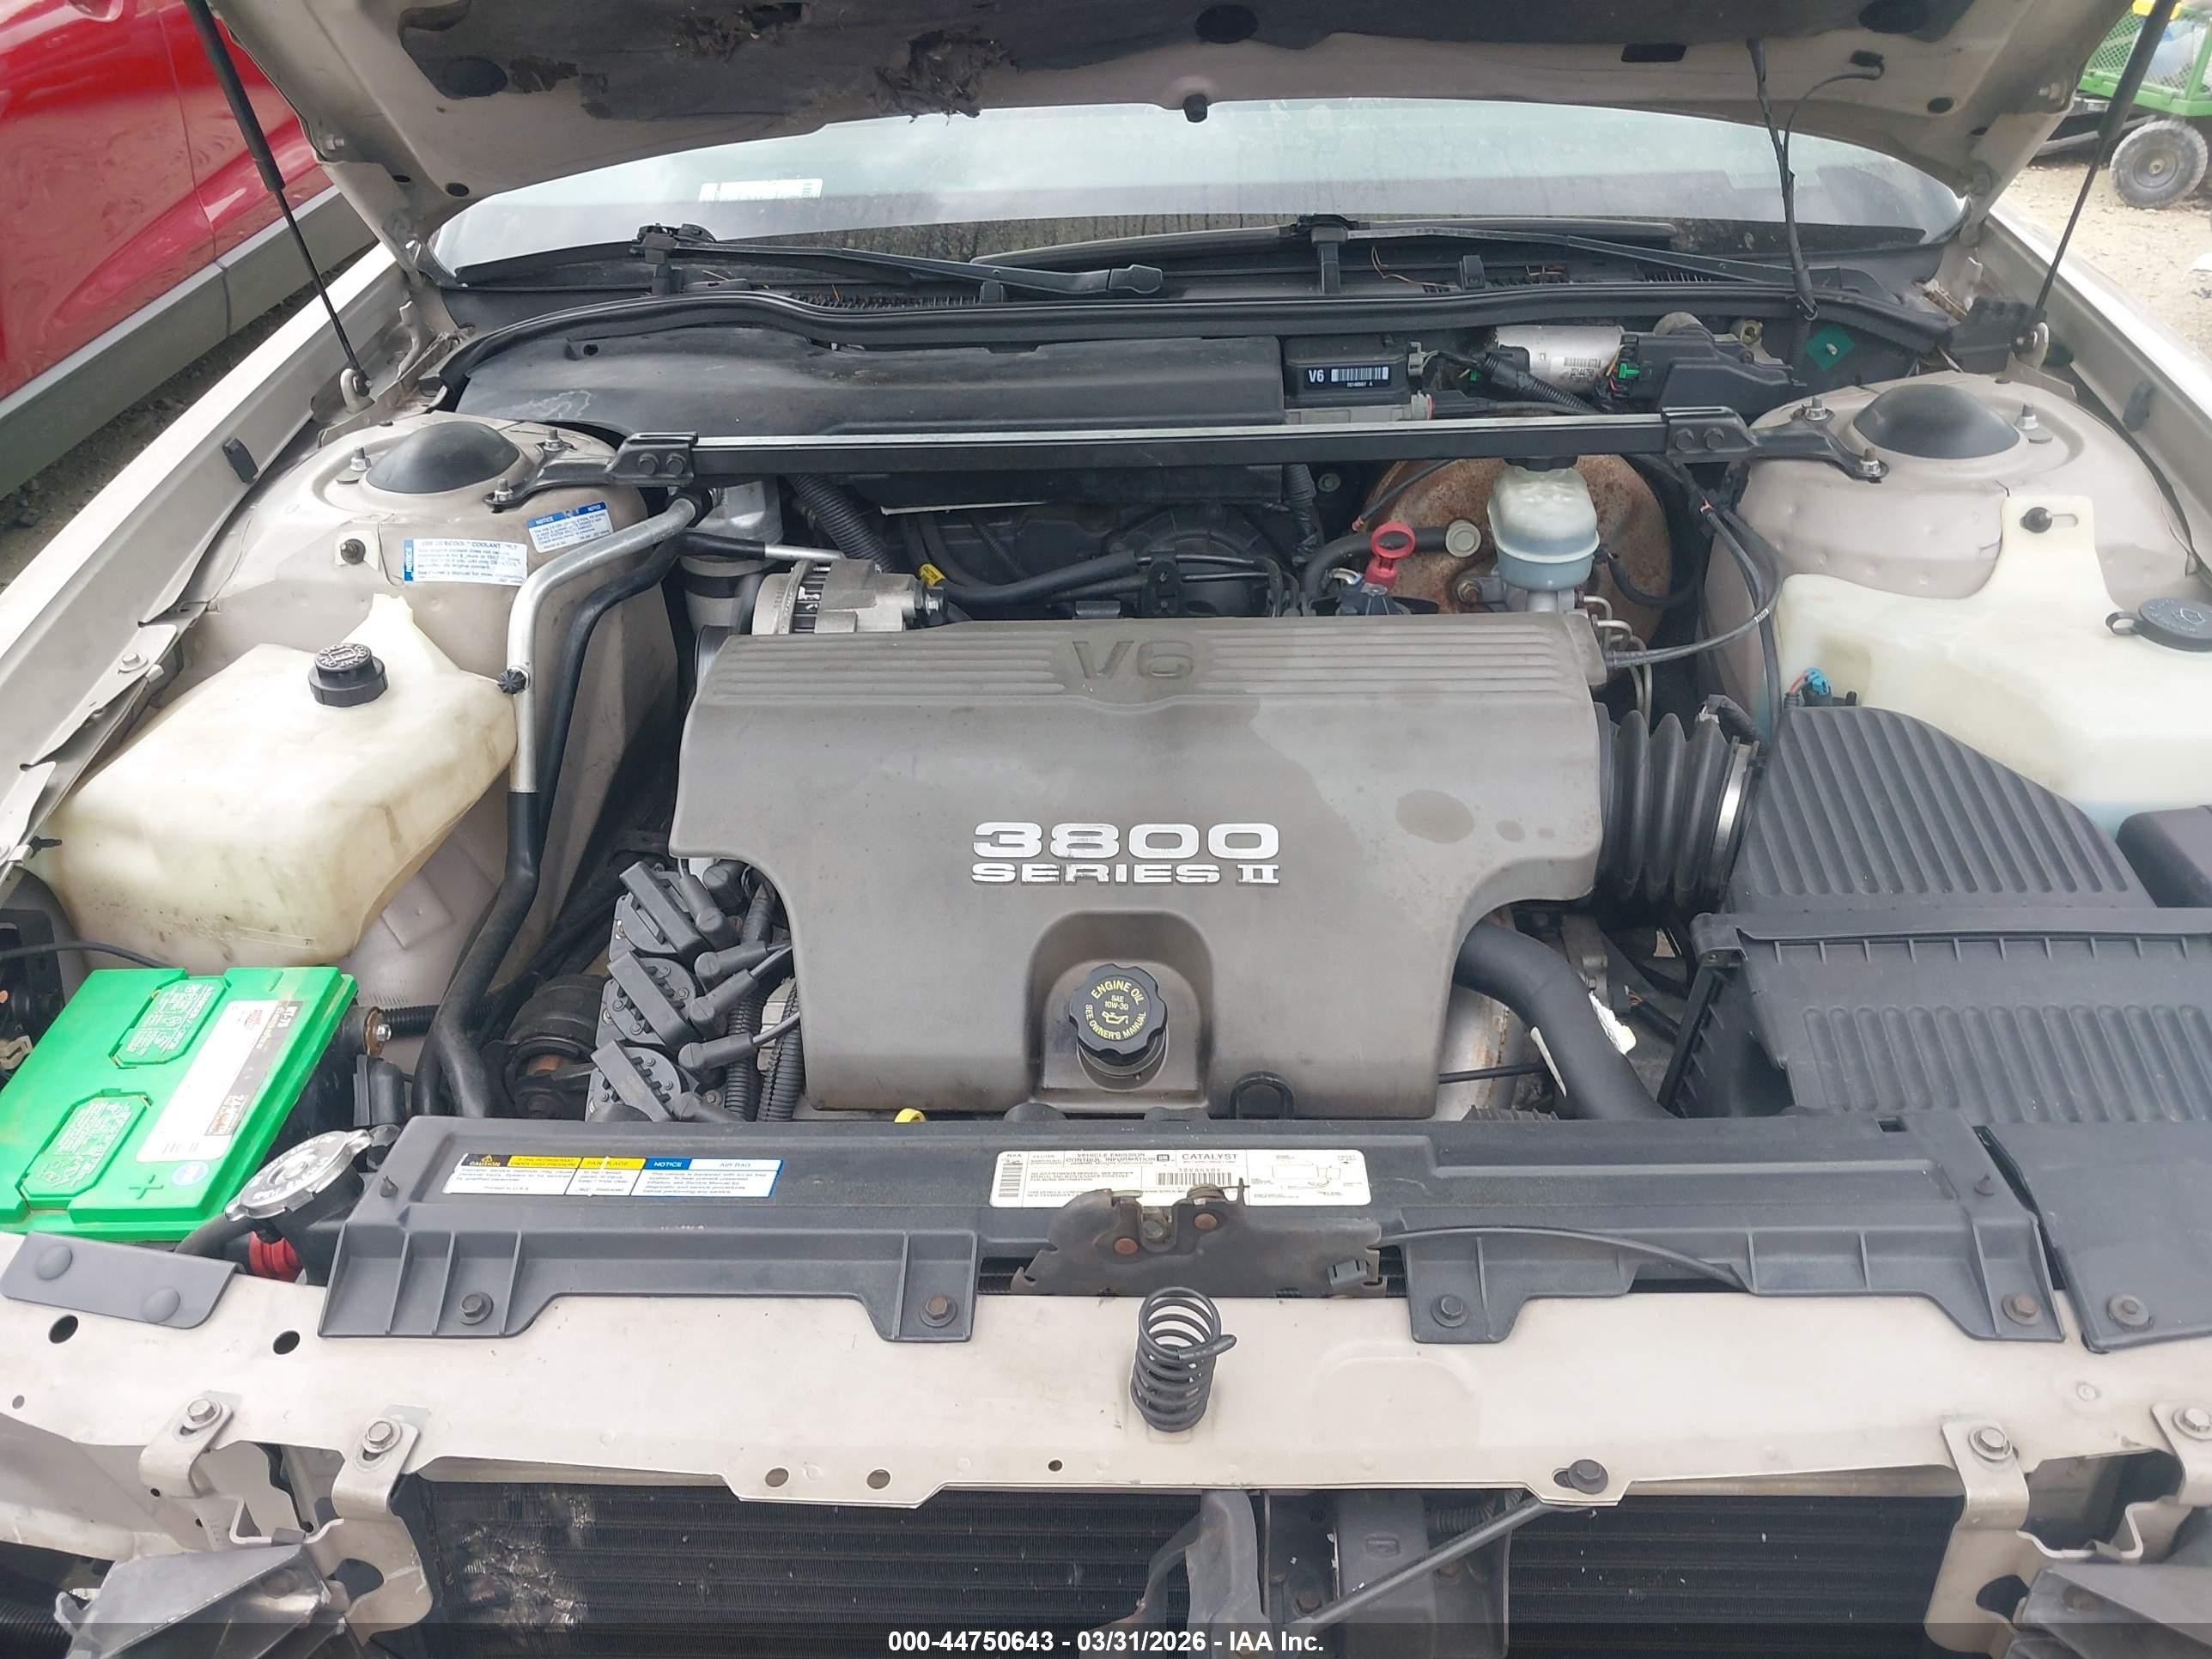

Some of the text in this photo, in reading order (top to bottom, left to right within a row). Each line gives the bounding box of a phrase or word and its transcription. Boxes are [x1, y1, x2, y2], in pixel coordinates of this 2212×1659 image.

[1309, 369, 1325, 383] V6
[535, 516, 554, 526] NOTICE
[1073, 641, 1194, 679] V6
[973, 822, 1279, 860] 3800
[971, 863, 1279, 884] SERIES II
[1091, 980, 1145, 1006] ENGINE OIL
[1104, 1000, 1129, 1011] 10W-30
[1085, 1004, 1146, 1040] SEE OWNER'S MANUAL
